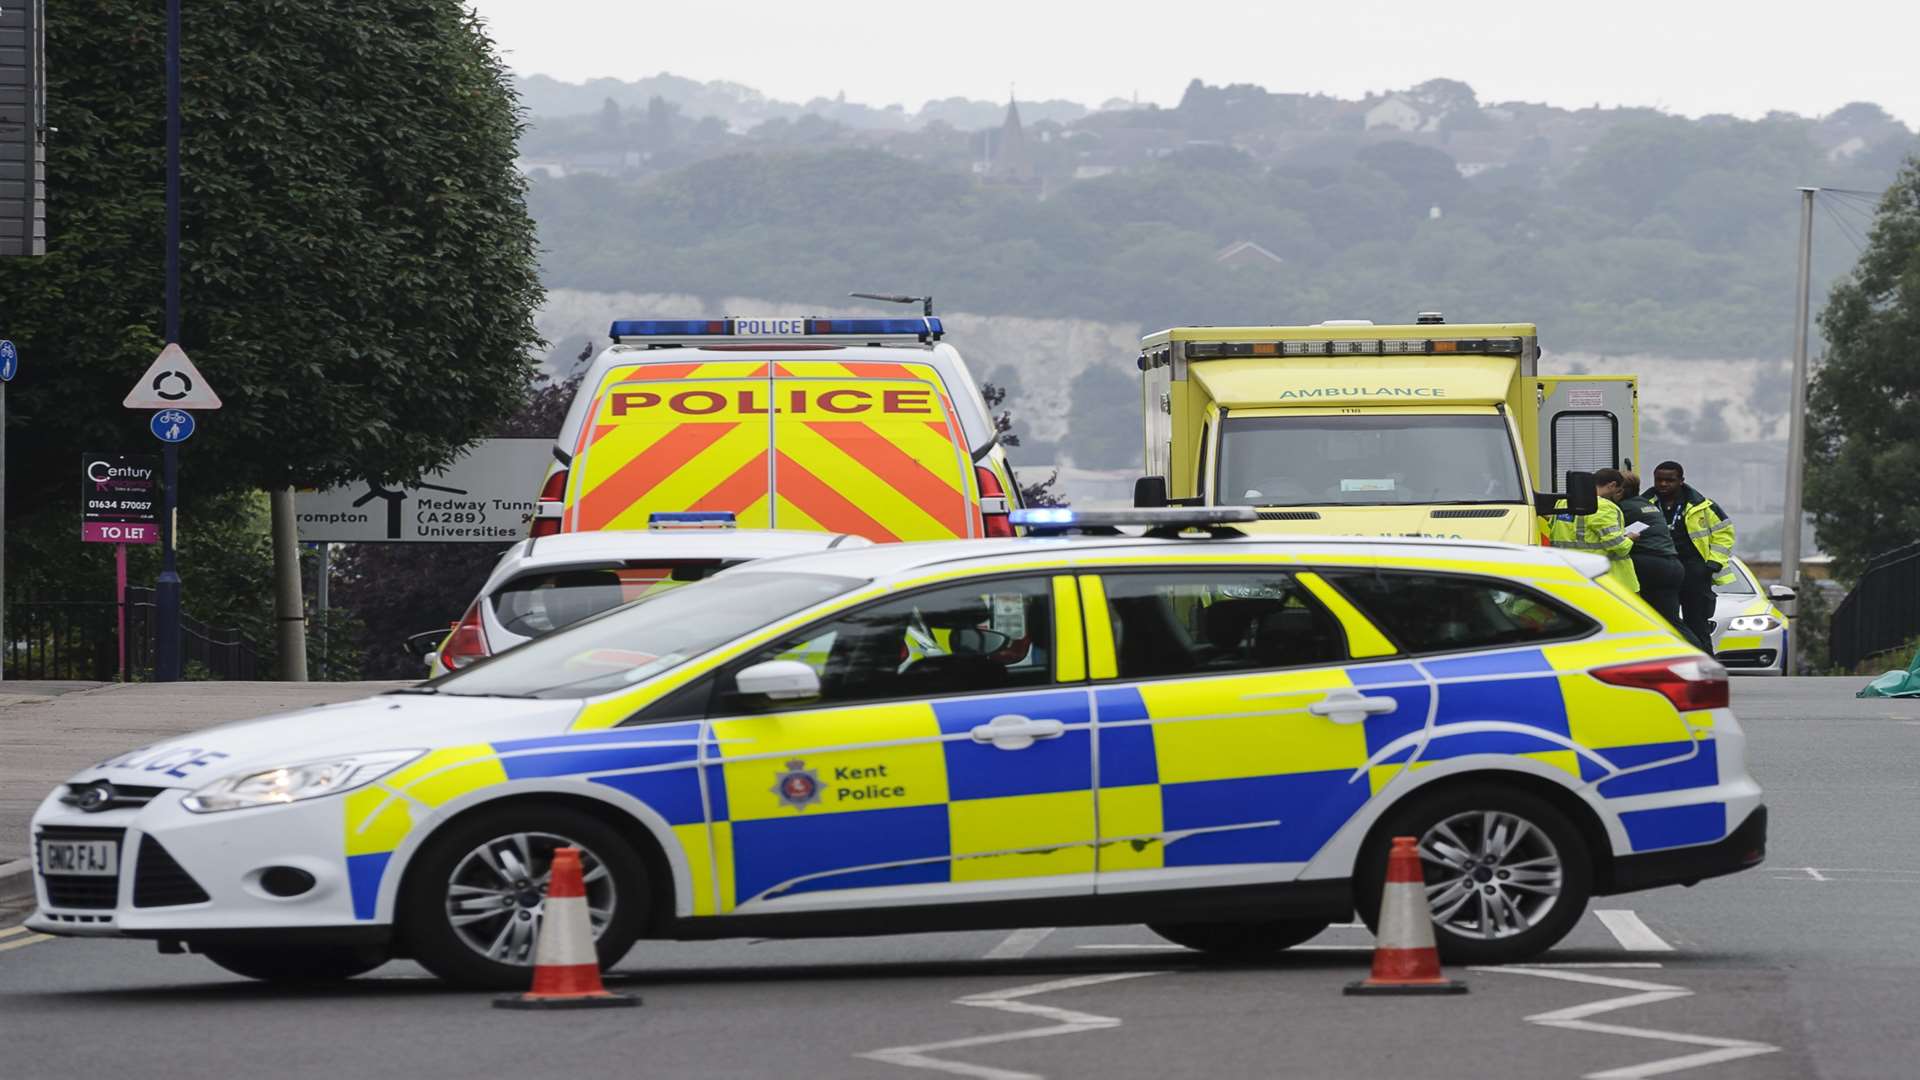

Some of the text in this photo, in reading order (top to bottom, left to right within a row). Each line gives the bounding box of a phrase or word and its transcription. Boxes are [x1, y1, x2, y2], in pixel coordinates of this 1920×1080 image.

[737, 320, 800, 335] POLICE
[1279, 387, 1446, 400] AMBULANCE
[611, 390, 932, 416] POLICE
[88, 461, 152, 482] Century
[88, 500, 152, 510] 01634 570057
[417, 499, 537, 512] Medway Tunn
[296, 512, 368, 524] rompton
[417, 512, 486, 524] (A289)
[101, 526, 144, 539] TO LET
[417, 526, 517, 538] Universities
[834, 764, 888, 780] Kent
[837, 785, 906, 801] Police
